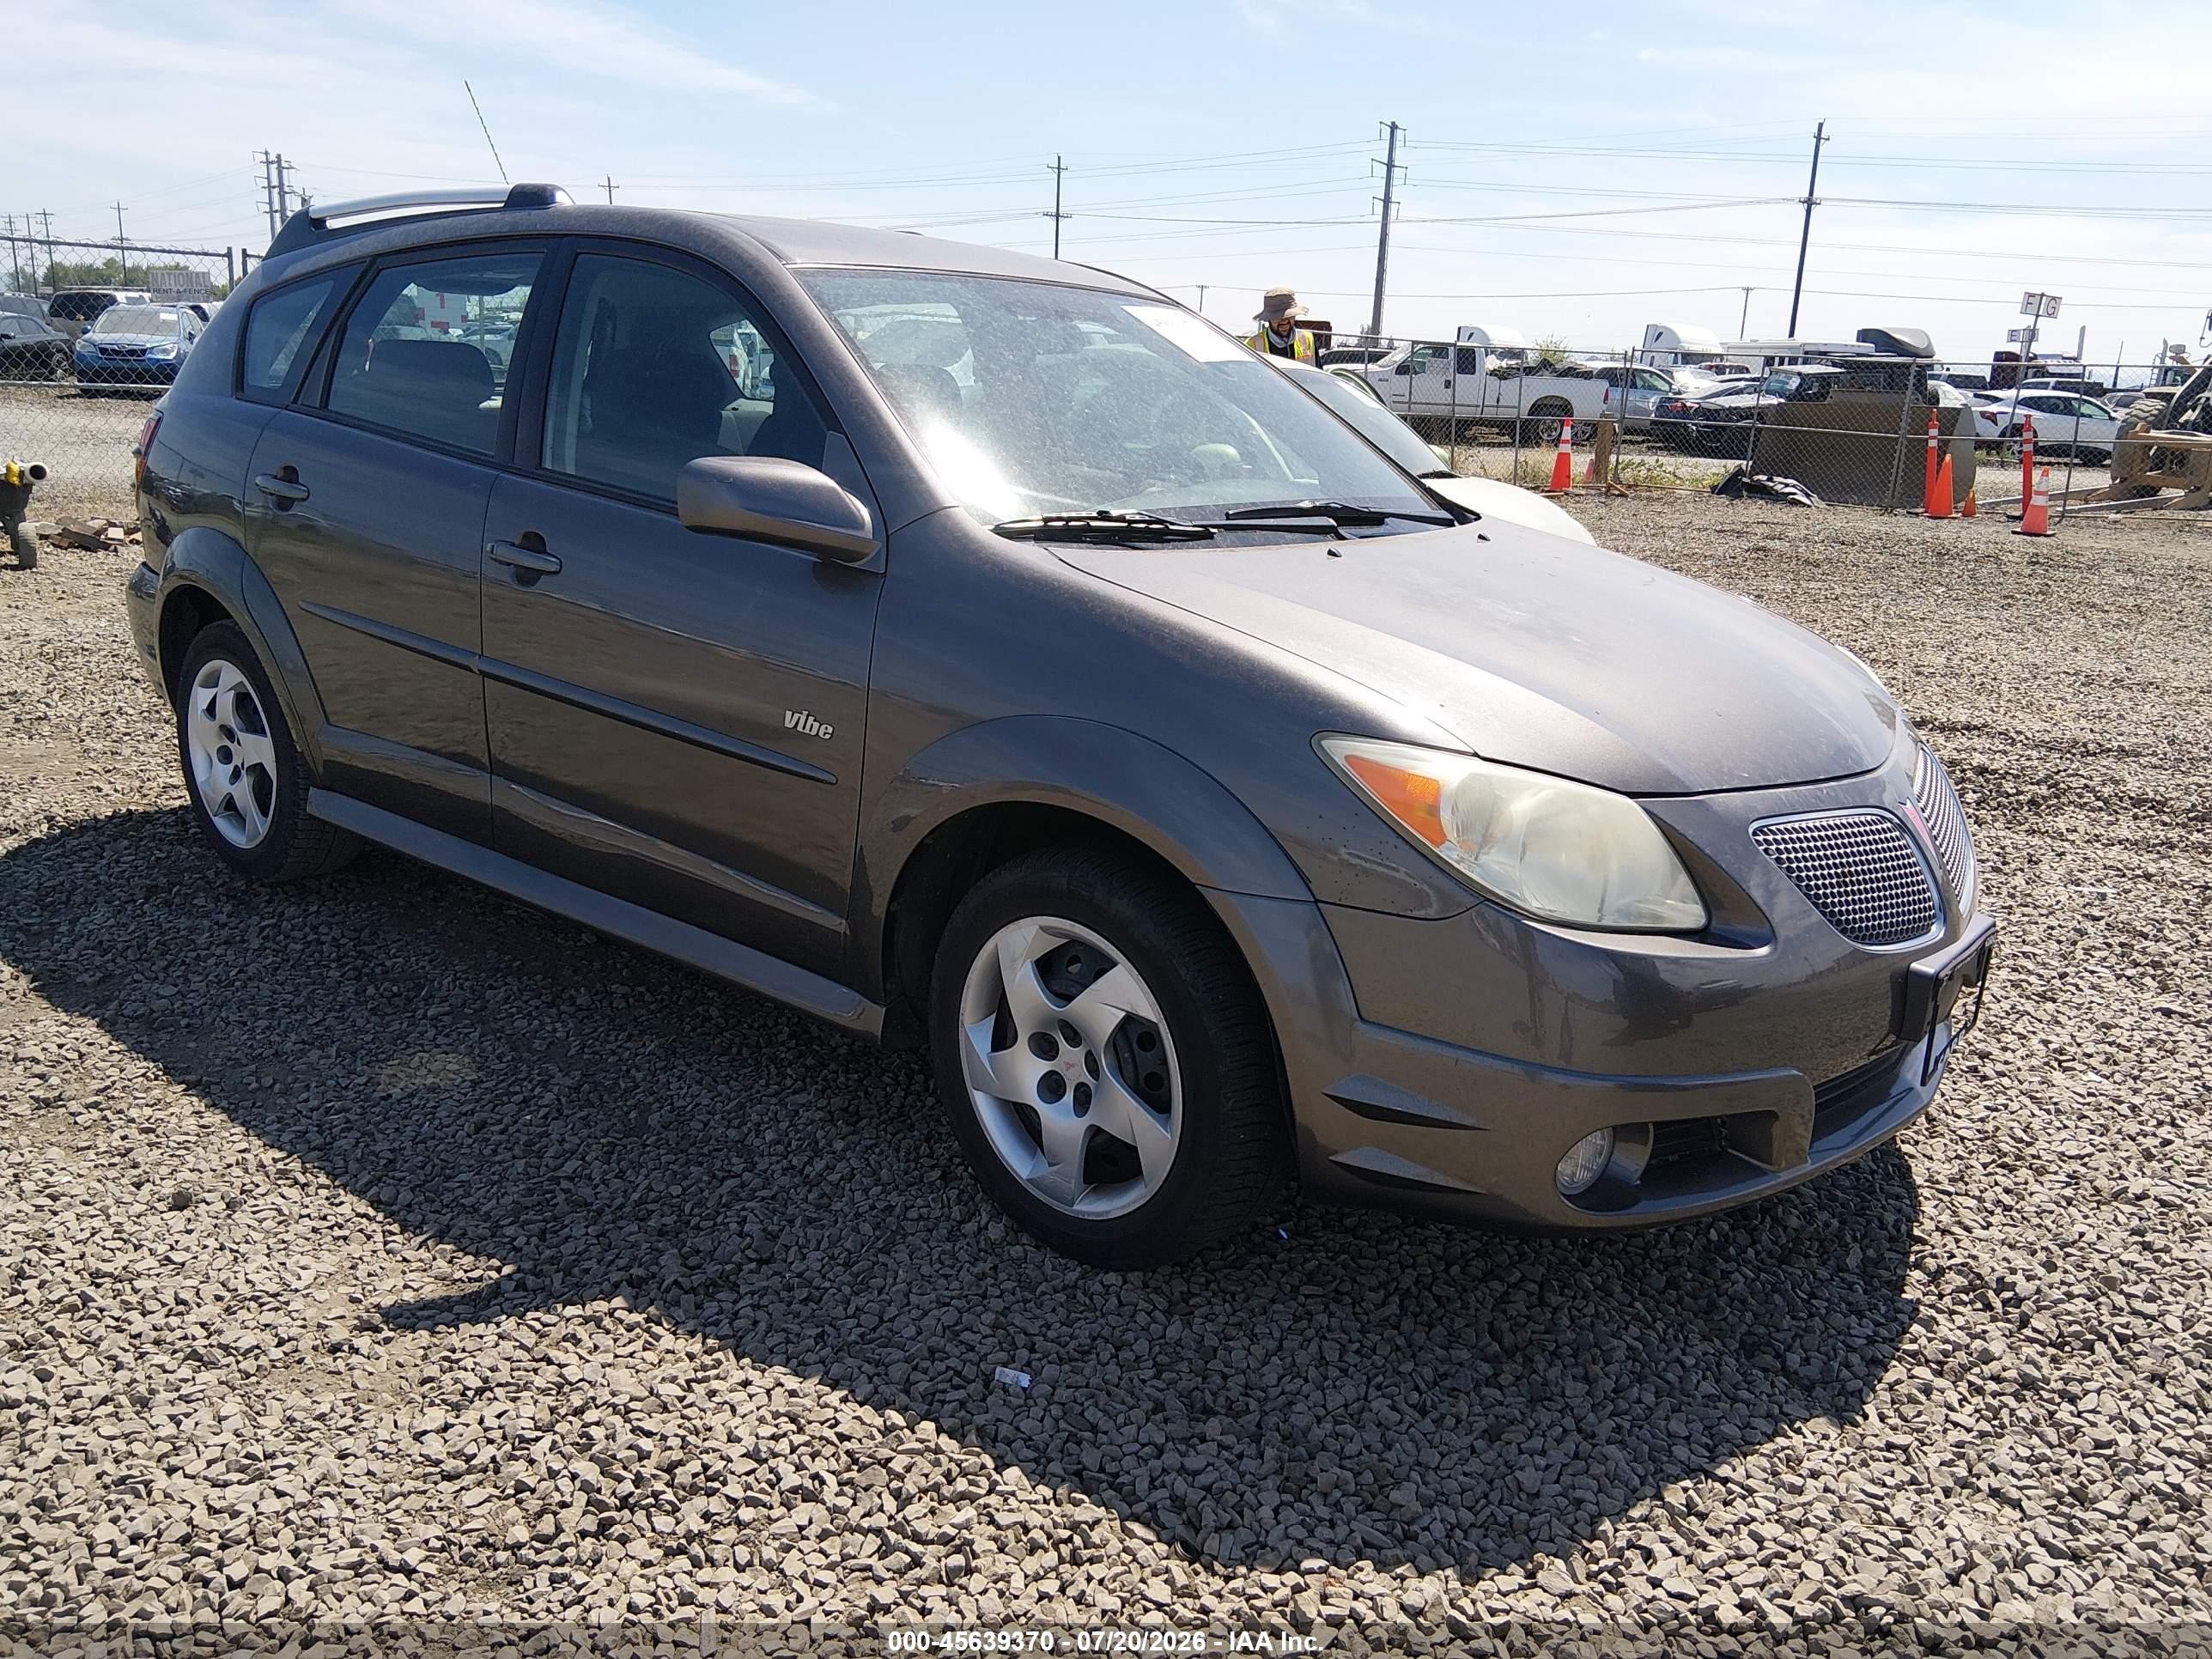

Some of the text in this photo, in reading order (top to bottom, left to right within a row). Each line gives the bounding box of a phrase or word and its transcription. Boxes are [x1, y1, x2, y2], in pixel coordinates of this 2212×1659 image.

[151, 271, 210, 288] NATIONAL
[2024, 295, 2057, 316] F G
[2010, 330, 2019, 342] E
[784, 710, 834, 739] vibe
